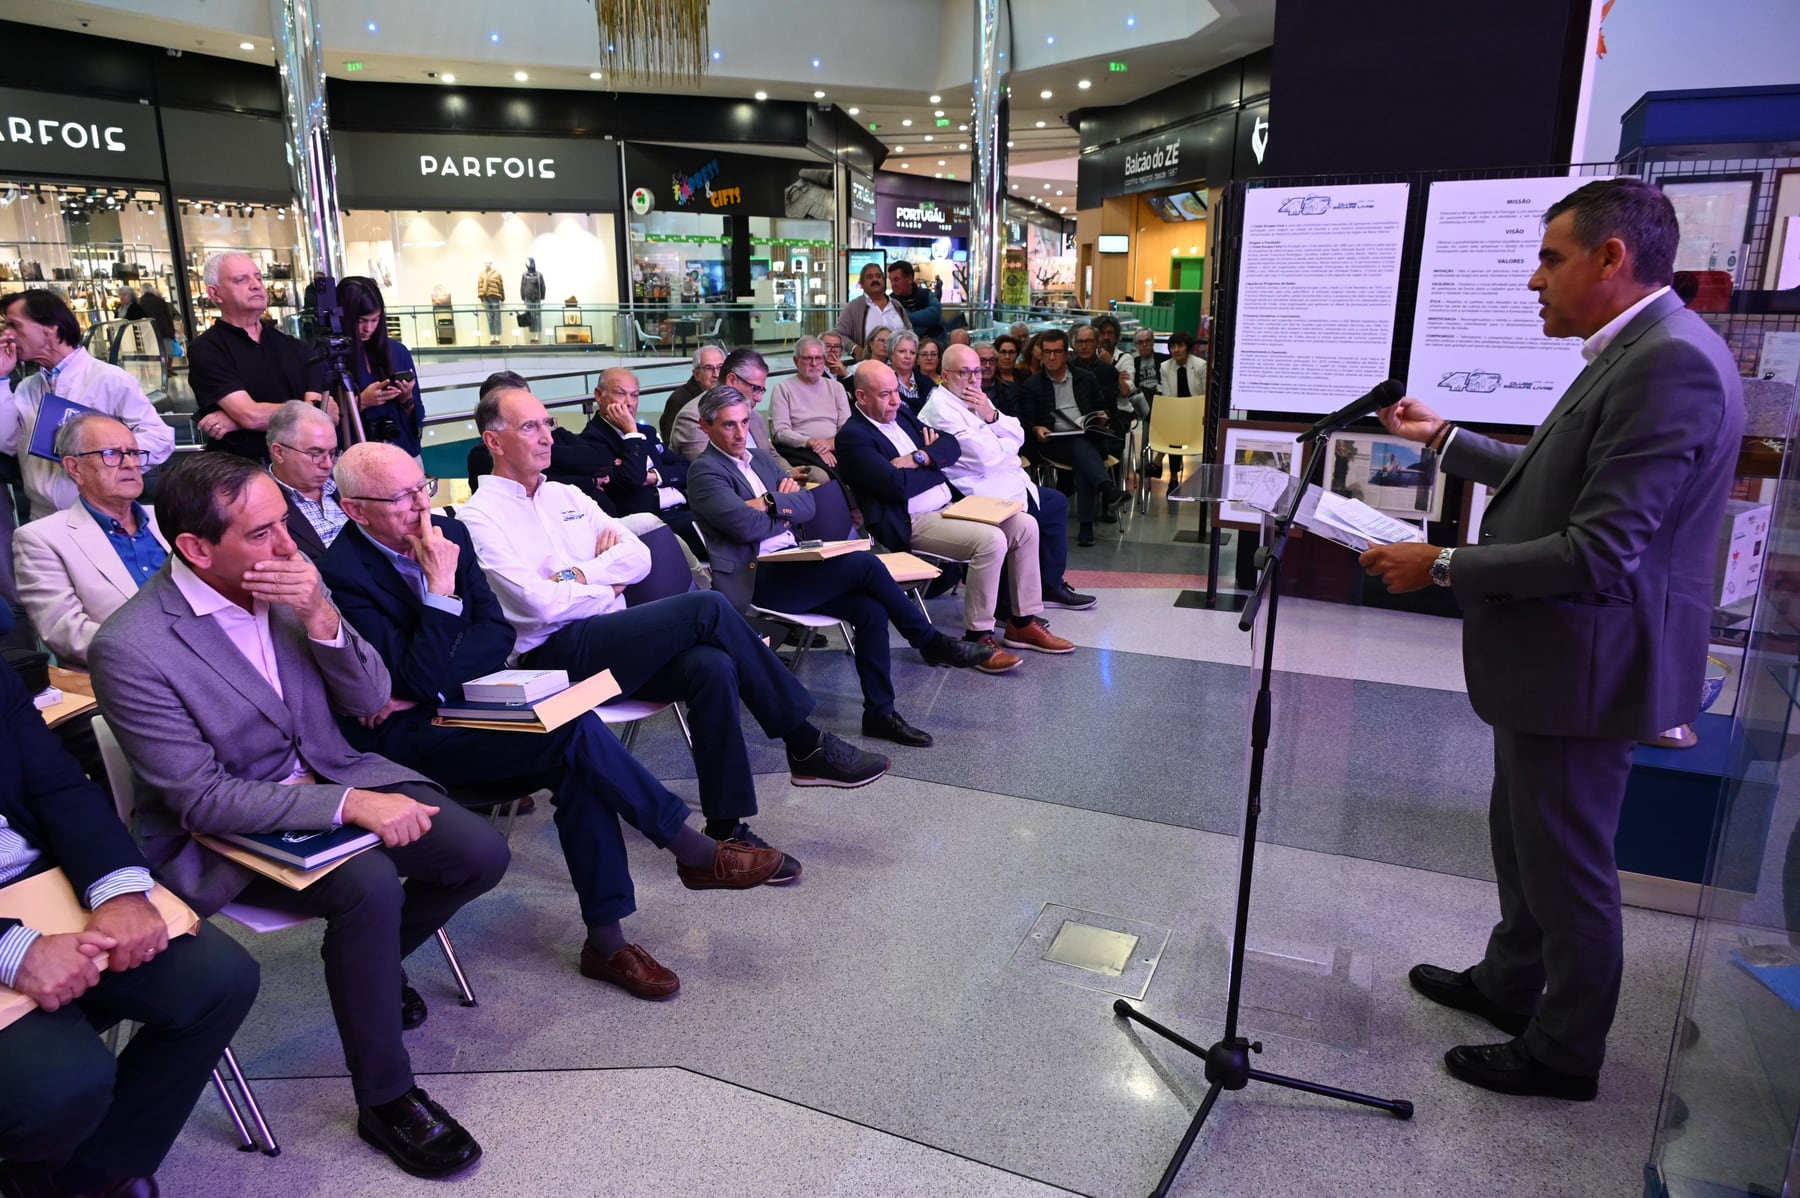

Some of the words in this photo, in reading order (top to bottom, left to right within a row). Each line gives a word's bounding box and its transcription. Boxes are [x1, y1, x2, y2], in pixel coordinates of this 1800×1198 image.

[0, 116, 126, 152] RFOIS
[420, 155, 556, 179] PARFOIS
[1125, 152, 1152, 176] Balcão
[1152, 146, 1164, 169] do
[710, 186, 741, 208] GIFTS
[896, 207, 945, 223] PORTUGÁL
